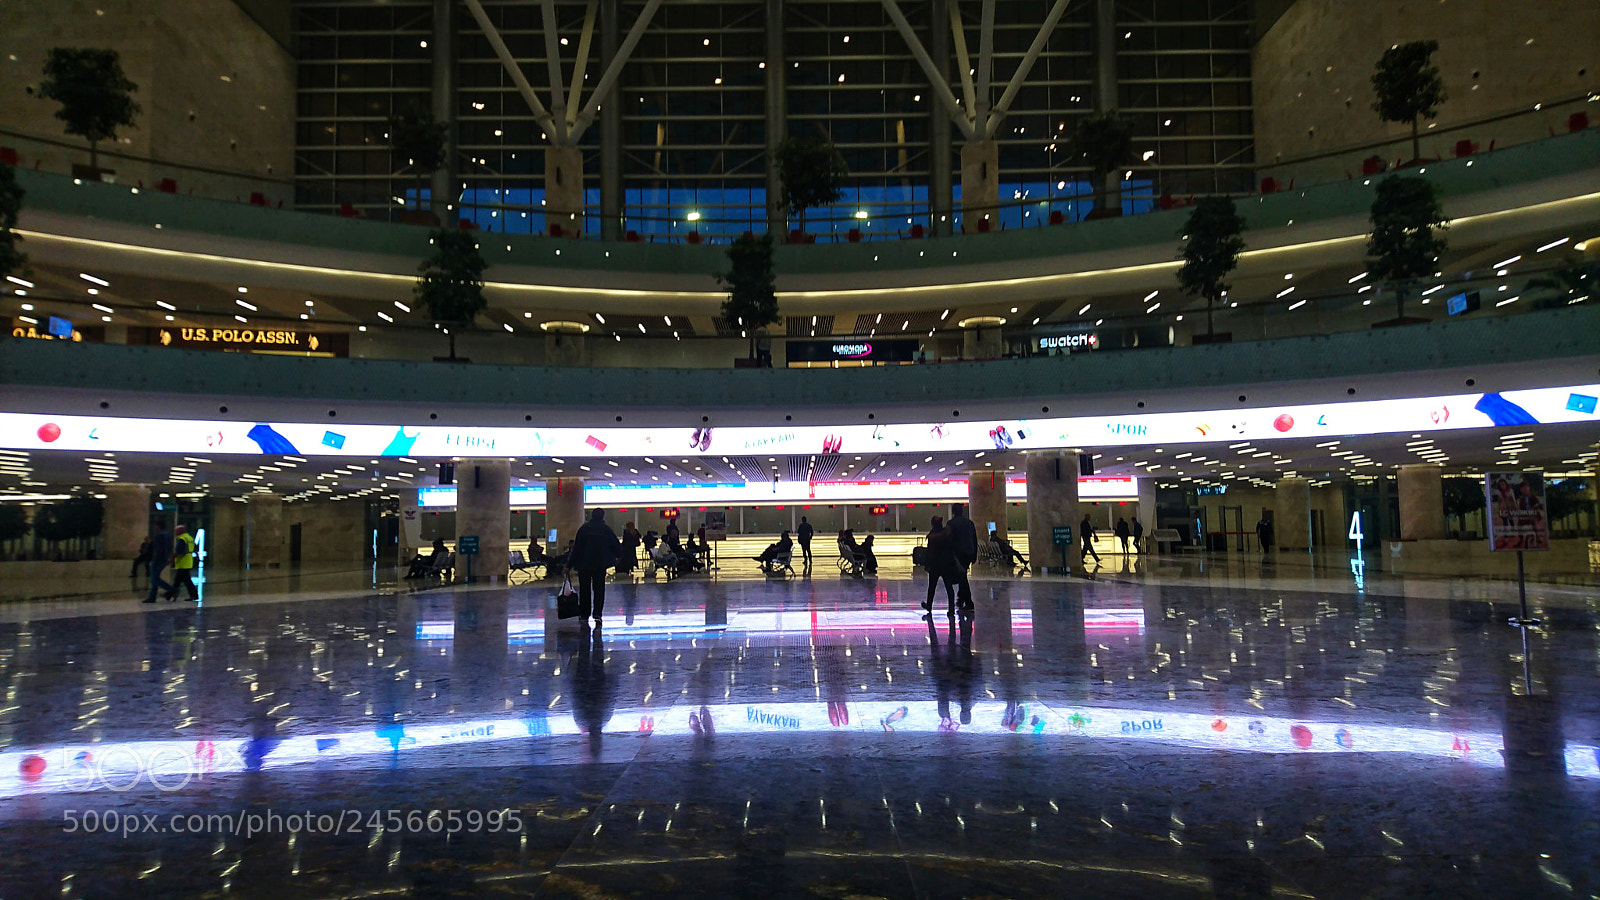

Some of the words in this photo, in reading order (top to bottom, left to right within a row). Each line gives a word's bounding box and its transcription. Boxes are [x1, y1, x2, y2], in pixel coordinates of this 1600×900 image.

[181, 328, 210, 342] U.S.
[212, 329, 254, 344] POLO
[255, 331, 299, 345] ASSN.
[1040, 333, 1088, 349] swatch
[1106, 423, 1148, 436] SPOR
[1349, 511, 1364, 546] 4
